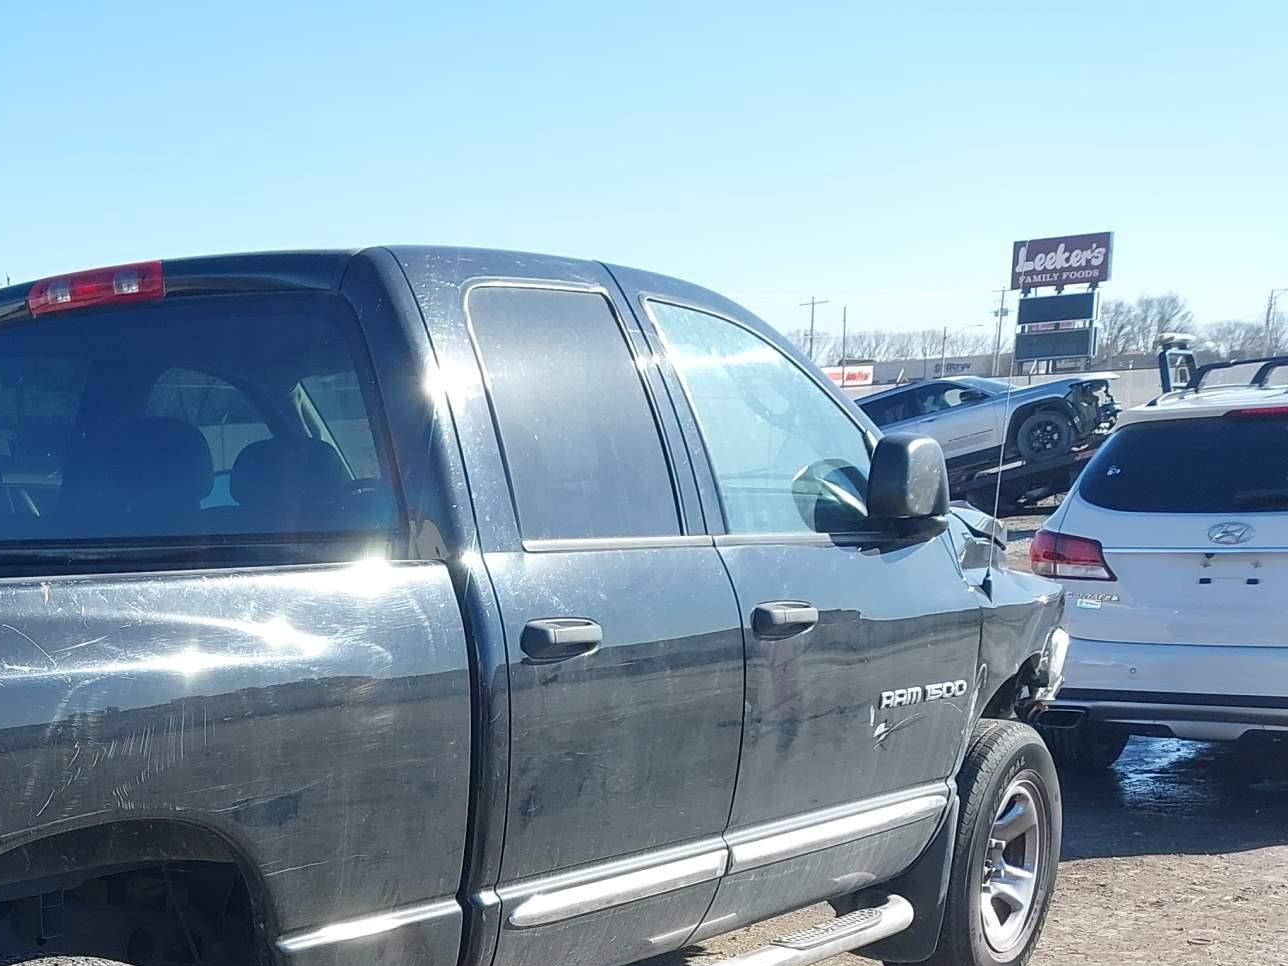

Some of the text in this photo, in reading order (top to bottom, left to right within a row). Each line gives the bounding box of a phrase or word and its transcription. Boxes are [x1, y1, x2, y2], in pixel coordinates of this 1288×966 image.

[1015, 243, 1106, 273] Leeker's
[1019, 269, 1099, 284] FAMILY FOODS
[880, 679, 968, 709] RAM 1500
